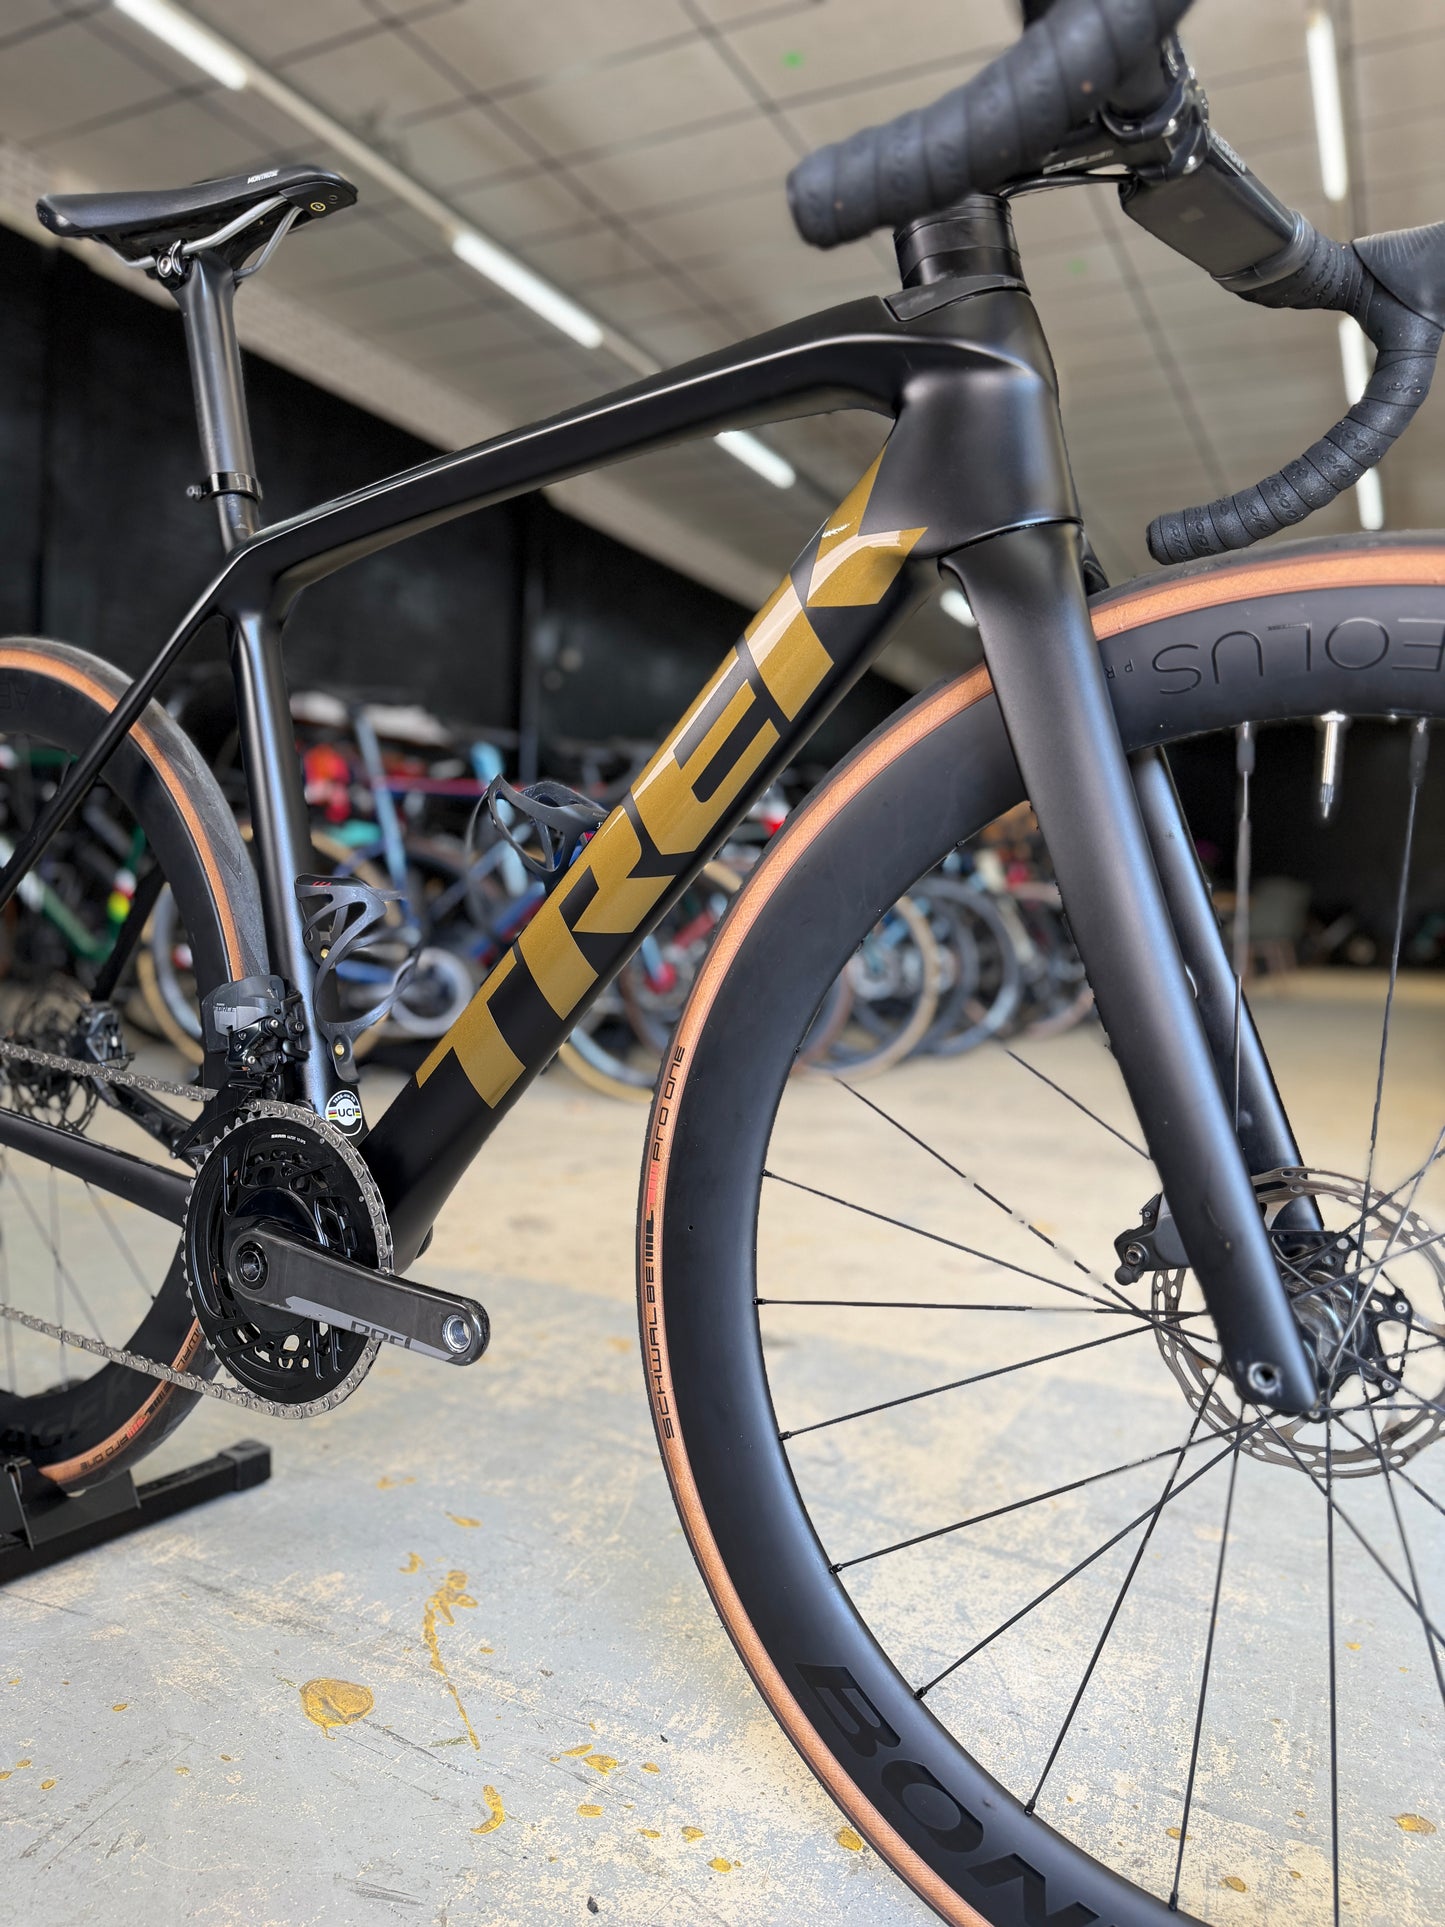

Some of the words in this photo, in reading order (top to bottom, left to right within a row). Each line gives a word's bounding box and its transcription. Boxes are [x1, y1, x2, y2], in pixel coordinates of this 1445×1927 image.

[1104, 659, 1134, 680] PR
[1152, 616, 1445, 694] EOLUS
[415, 442, 928, 1108] TREK
[646, 1266, 675, 1439] SCHWALBE
[795, 1663, 1118, 1927] BON
